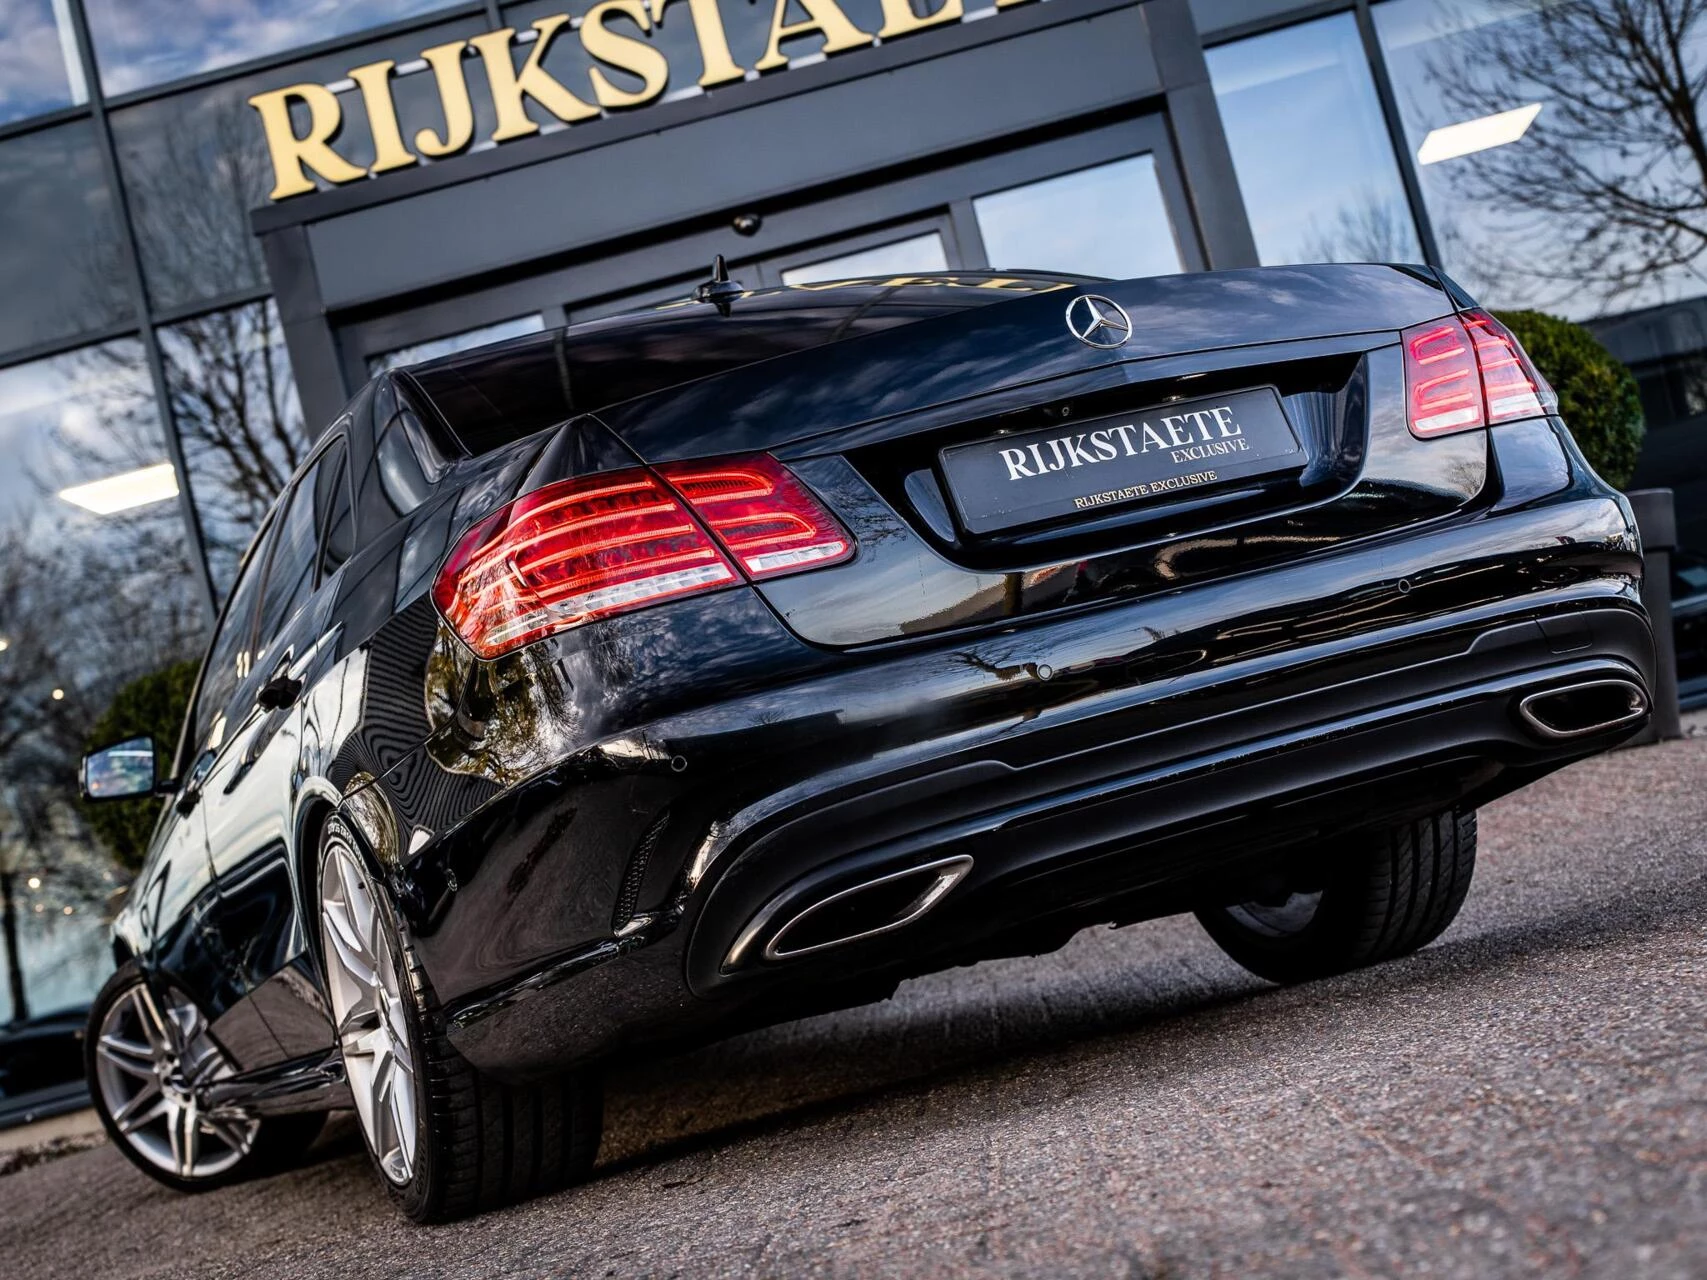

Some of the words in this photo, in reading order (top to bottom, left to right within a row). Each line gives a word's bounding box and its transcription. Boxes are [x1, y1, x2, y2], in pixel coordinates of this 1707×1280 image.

[248, 0, 1040, 200] RIJKSTA
[999, 407, 1242, 481] RIJKSTAETE
[1171, 438, 1249, 464] EXCLUSIVE
[1074, 485, 1149, 508] RIJKSTAETE
[1150, 470, 1218, 493] EXCLUSIVE
